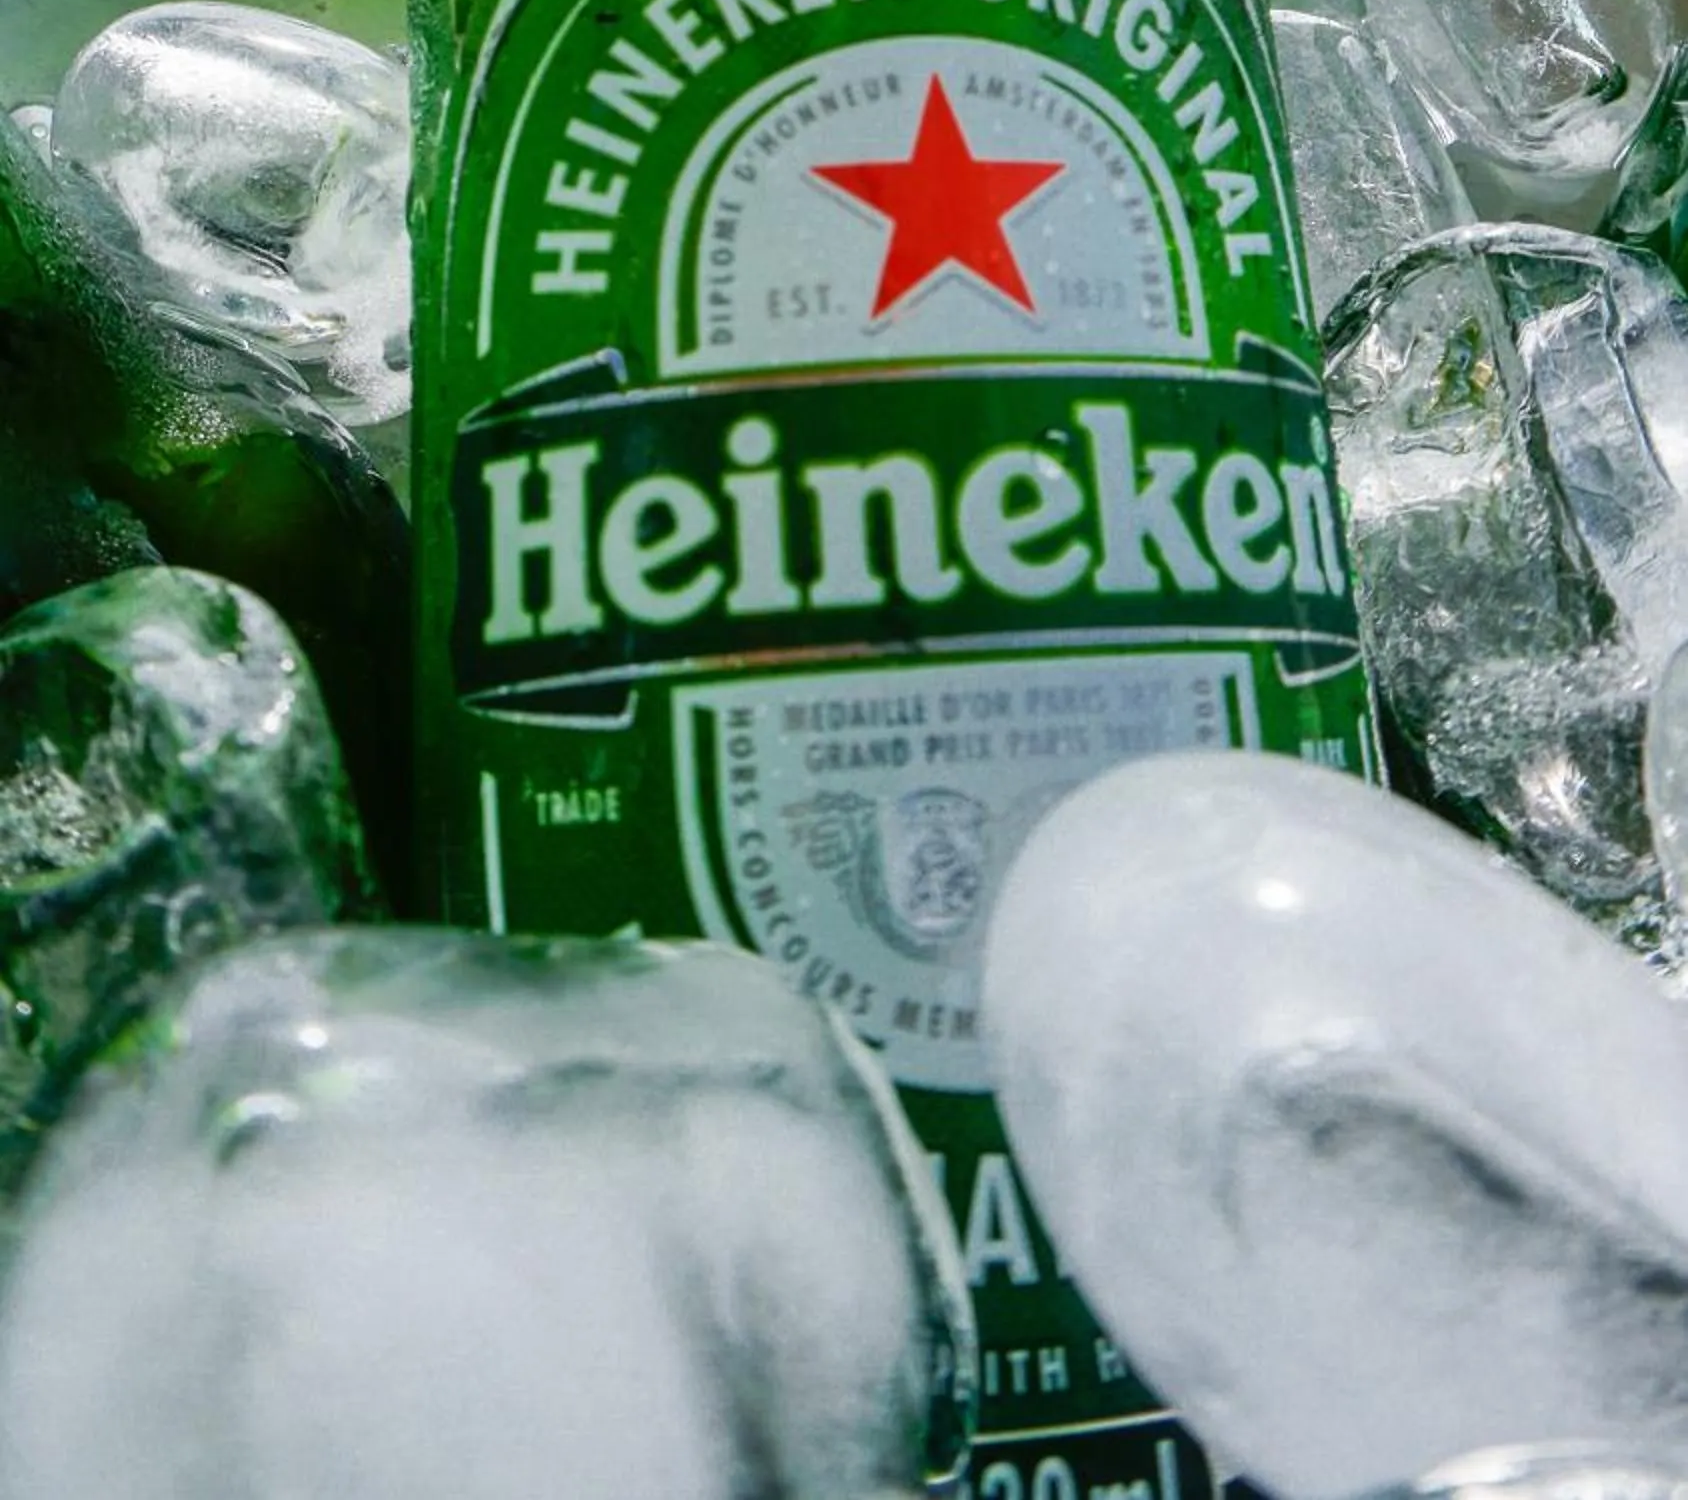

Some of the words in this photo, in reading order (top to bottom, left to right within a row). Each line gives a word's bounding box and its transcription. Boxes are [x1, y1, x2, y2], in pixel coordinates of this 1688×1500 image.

[765, 283, 848, 321] EST.
[482, 401, 1345, 646] Heineken
[804, 734, 912, 775] GRAND
[534, 784, 622, 827] TRADE
[893, 999, 980, 1041] MEM
